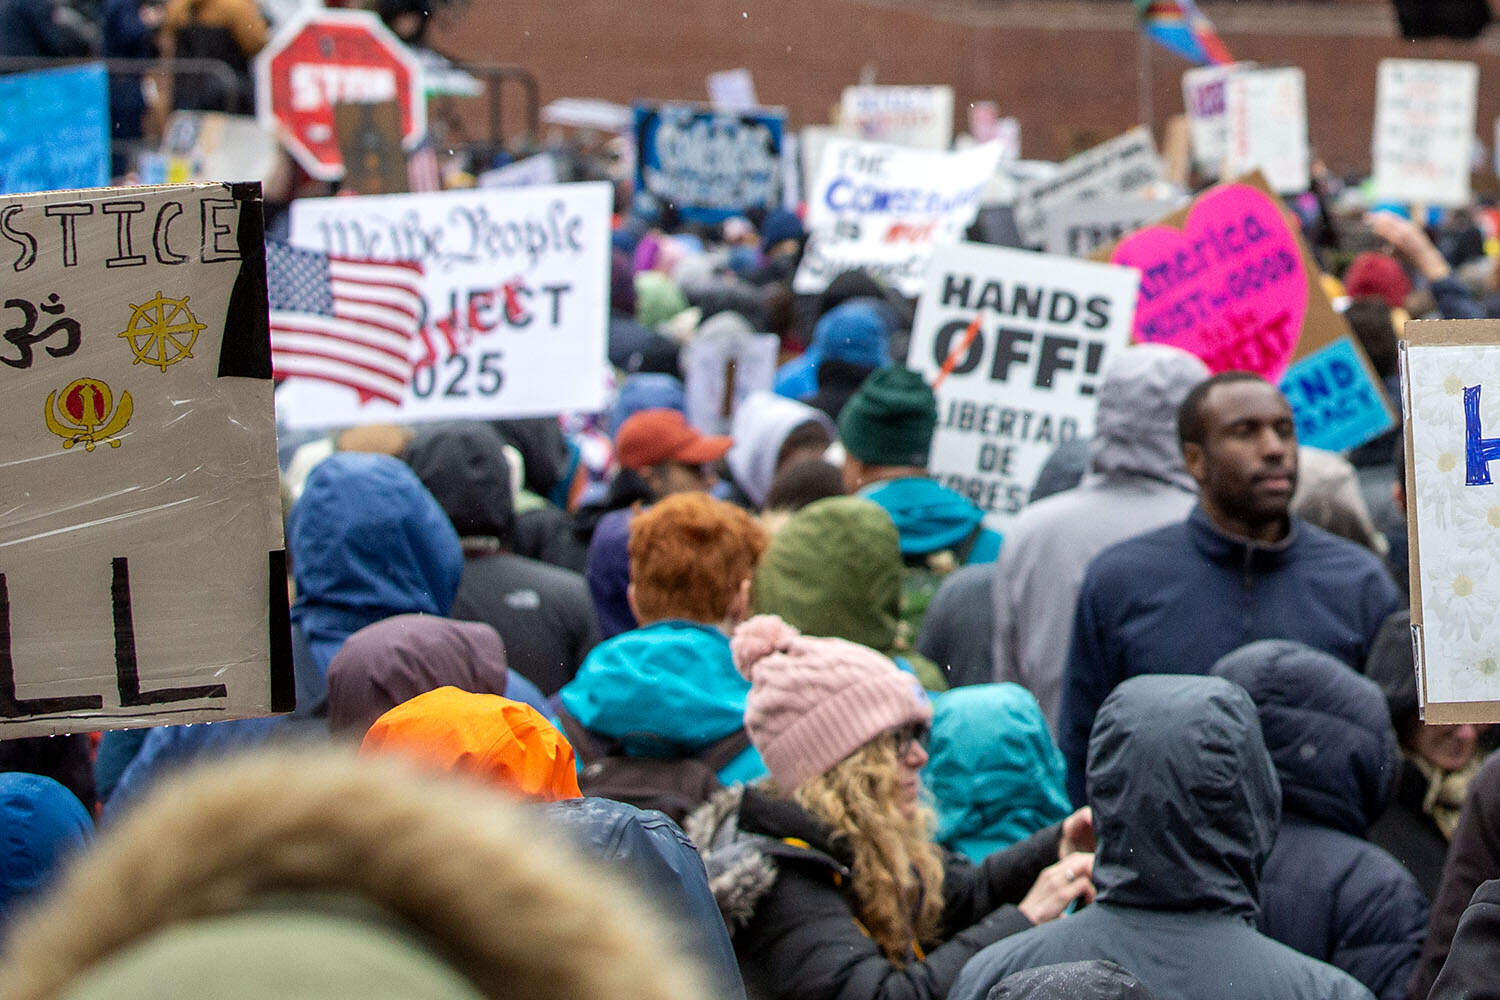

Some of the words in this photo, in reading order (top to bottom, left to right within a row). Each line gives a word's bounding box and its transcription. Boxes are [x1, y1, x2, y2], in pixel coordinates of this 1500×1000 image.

[390, 208, 444, 258] the
[446, 200, 583, 272] People
[941, 273, 1114, 331] HANDS
[411, 351, 504, 398] 025
[934, 317, 1105, 396] OFF!
[944, 400, 1078, 446] IBERTAD
[979, 443, 1018, 477] DE
